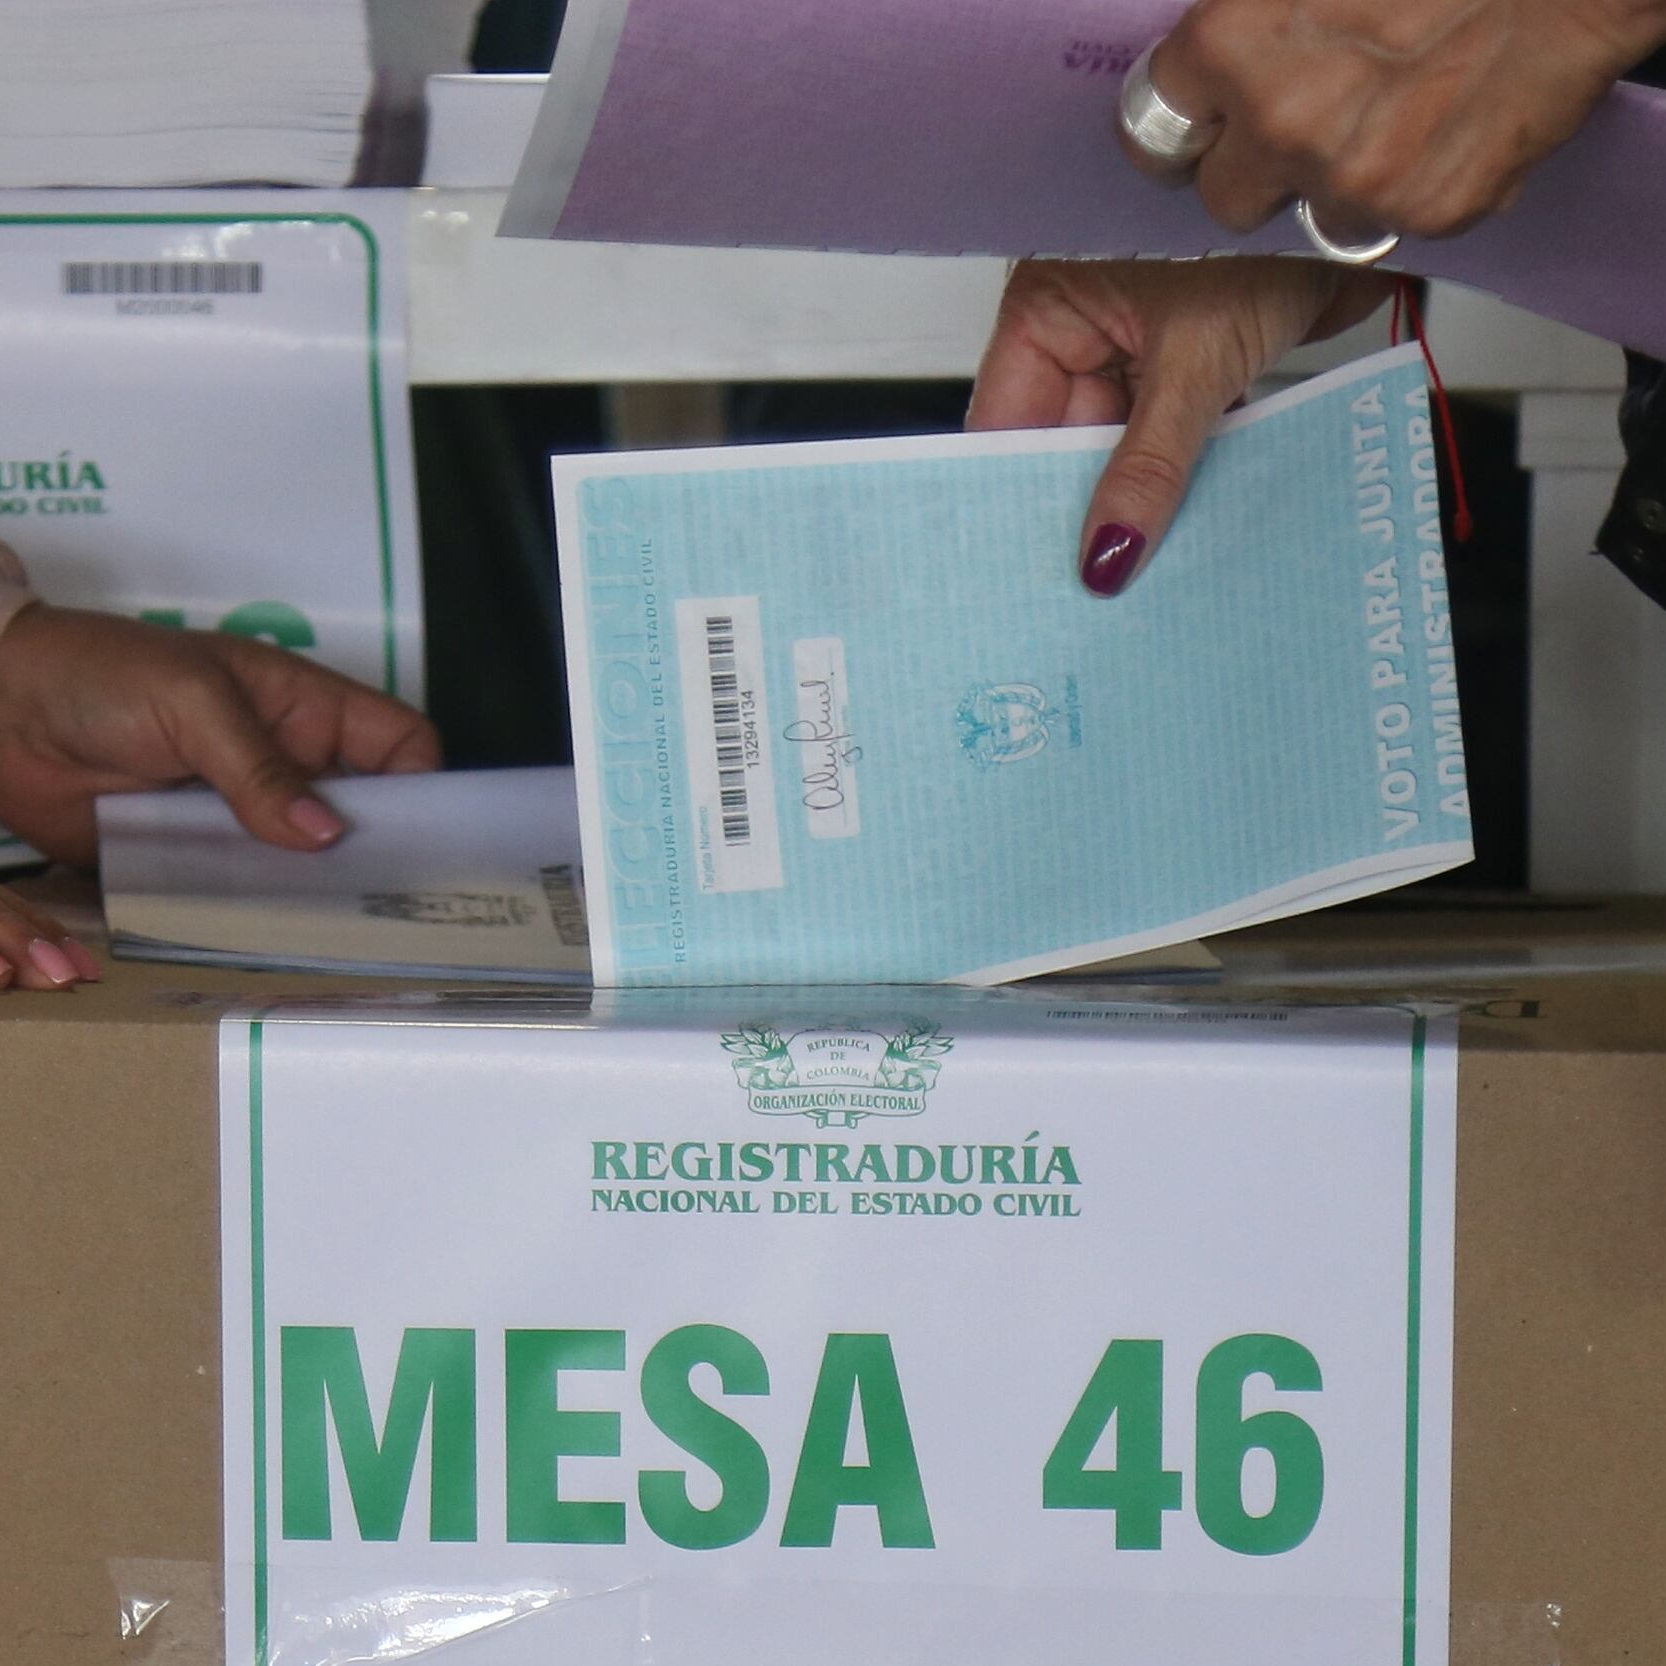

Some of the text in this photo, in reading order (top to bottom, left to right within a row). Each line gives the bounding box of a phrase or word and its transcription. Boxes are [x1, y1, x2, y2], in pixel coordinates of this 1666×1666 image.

[46, 498, 107, 515] CIVIL
[1352, 382, 1421, 841] VOTO PARA JUNTA
[740, 690, 761, 769] 13294134
[640, 538, 687, 963] REGISTRADURIA NACIONAL DEL ESTADO CIVIL
[806, 1068, 870, 1081] COLOMBIA
[829, 1051, 846, 1061] DE
[753, 1088, 921, 1111] ORGANIZACIÓN ELECTORAL
[590, 1130, 1082, 1185] REGISTRADURÍA
[590, 1189, 1082, 1217] NACIONAL DEL ESTADO CIVIL
[280, 1324, 1326, 1556] MESA 46
